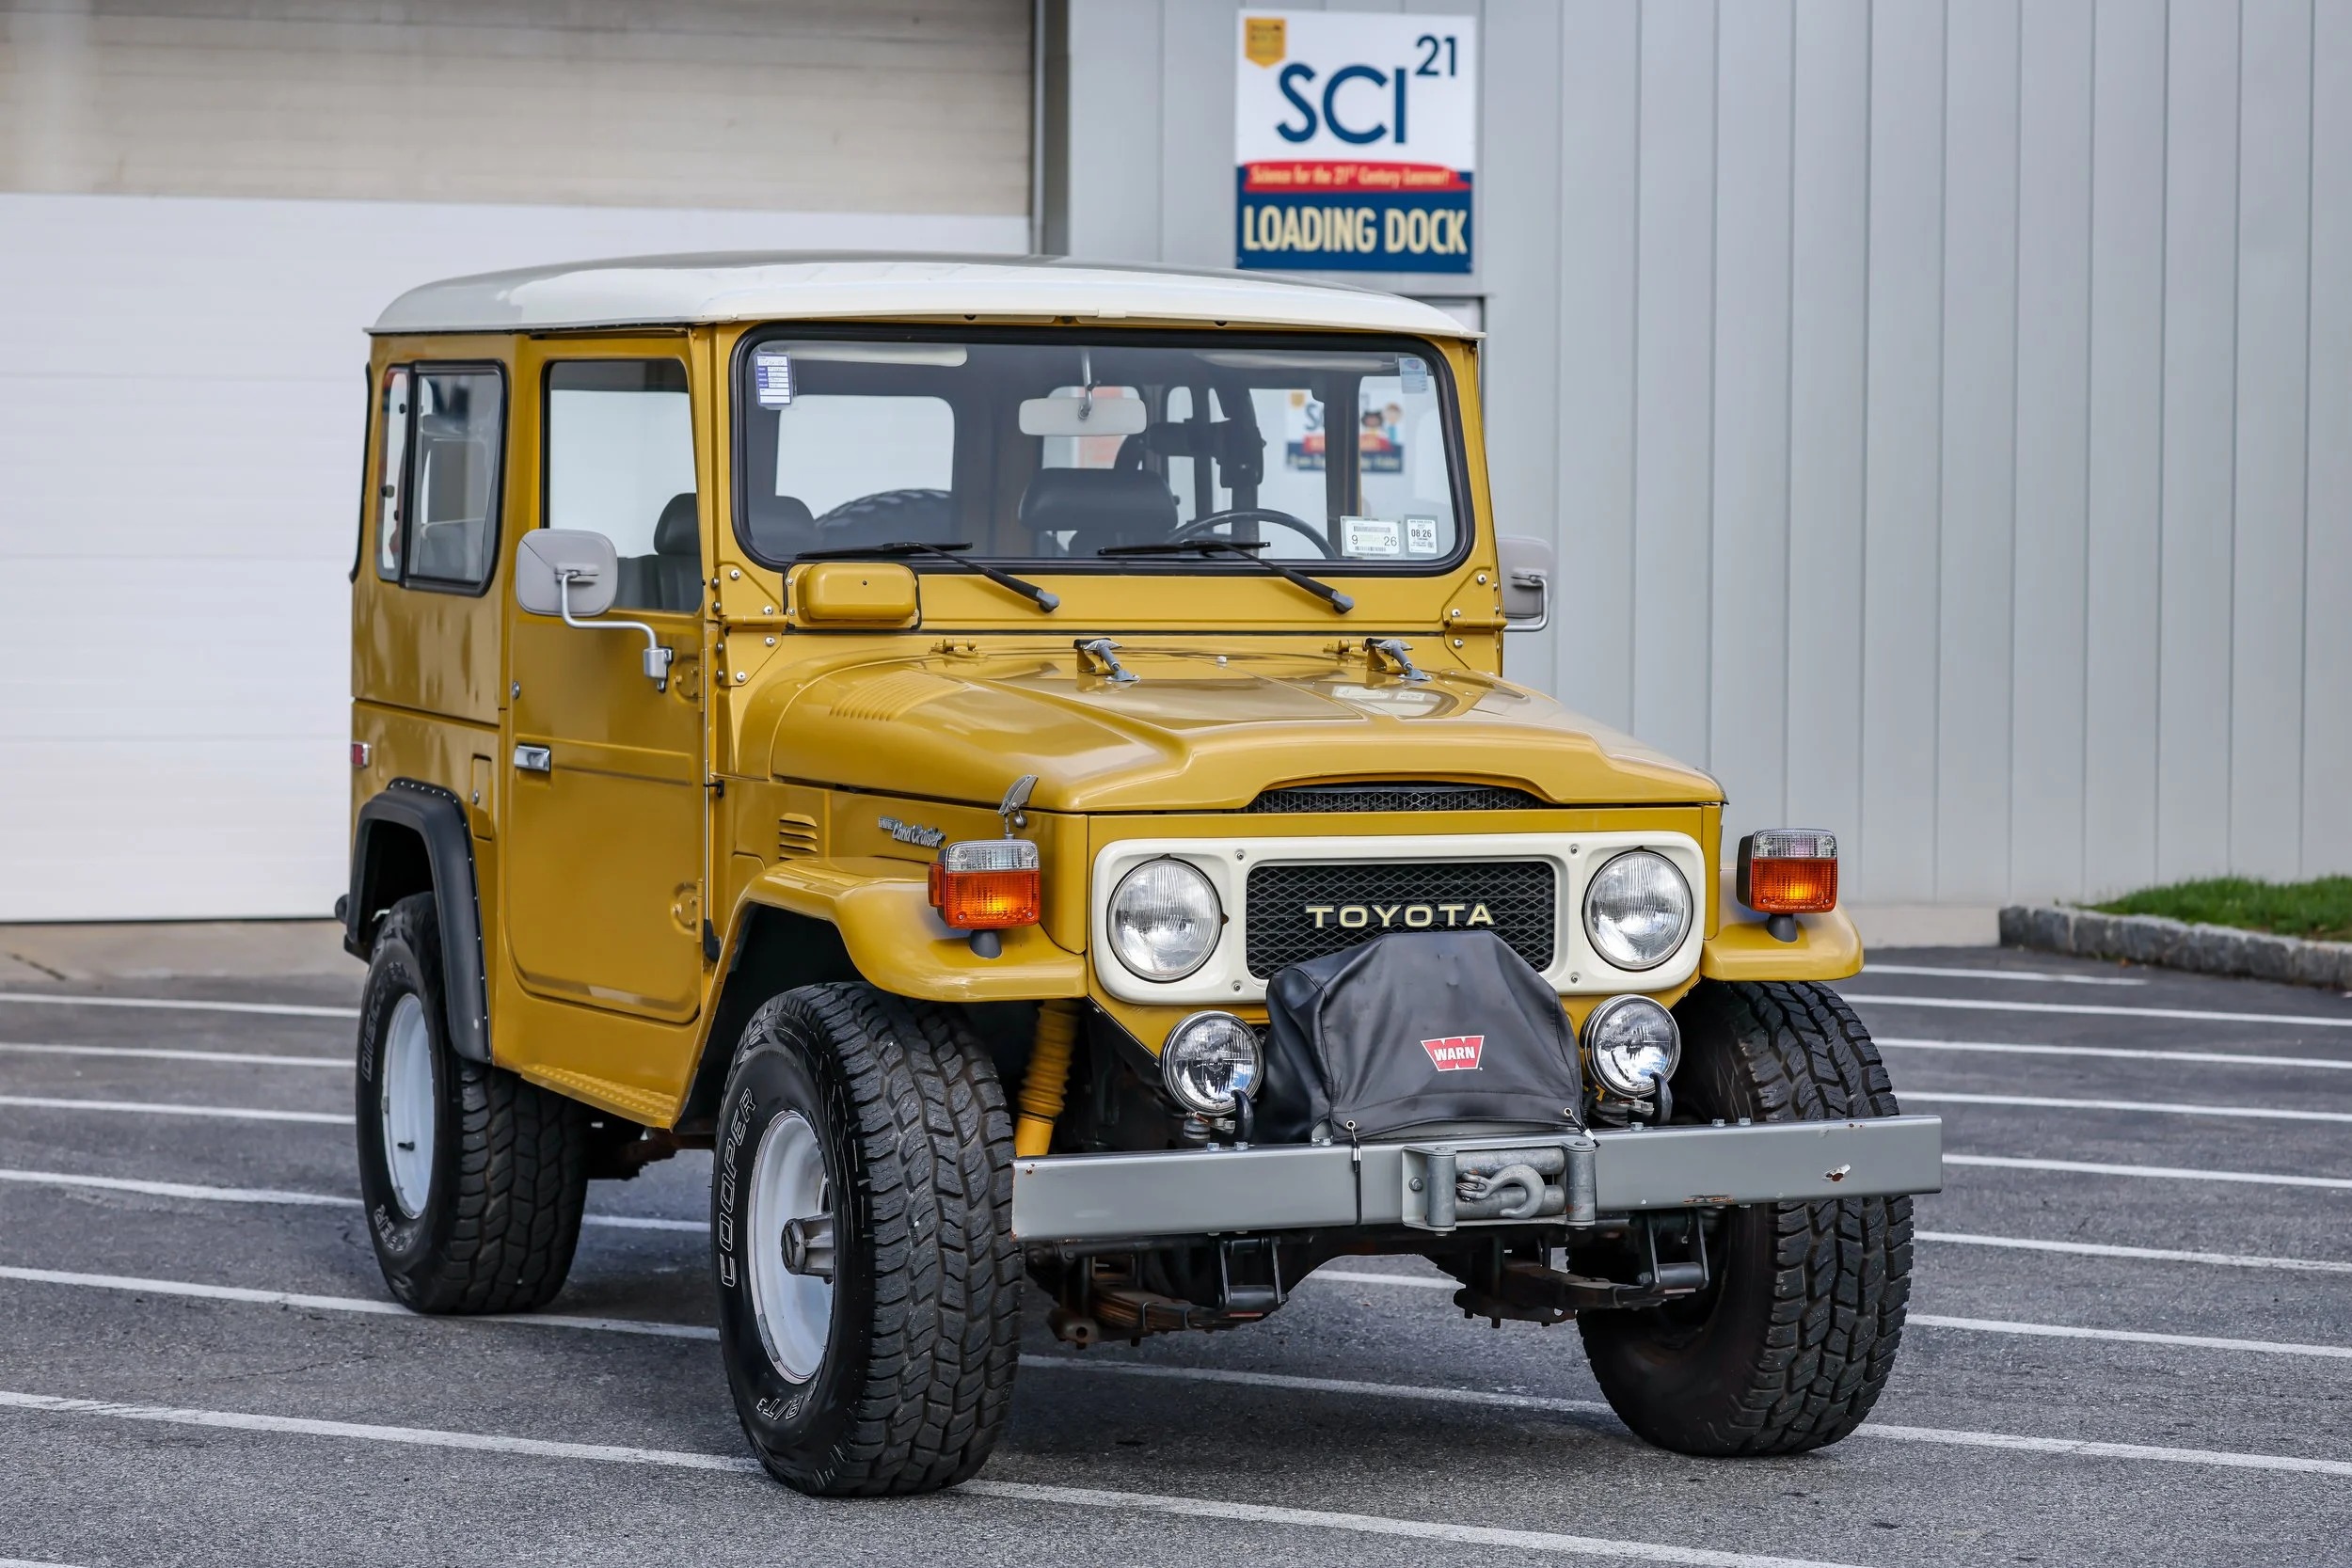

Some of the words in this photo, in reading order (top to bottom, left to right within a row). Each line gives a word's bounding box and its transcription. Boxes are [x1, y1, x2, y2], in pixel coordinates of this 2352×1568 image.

[1276, 62, 1406, 144] SCI
[1415, 35, 1456, 77] 21
[1243, 205, 1377, 254] LOADING
[1385, 208, 1468, 255] DOCK
[1351, 534, 1359, 546] 9
[1384, 535, 1397, 546] 26
[1422, 529, 1432, 538] 26
[1305, 902, 1496, 929] TOYOTA
[1433, 1045, 1476, 1062] WARN
[719, 1087, 757, 1288] COOPER
